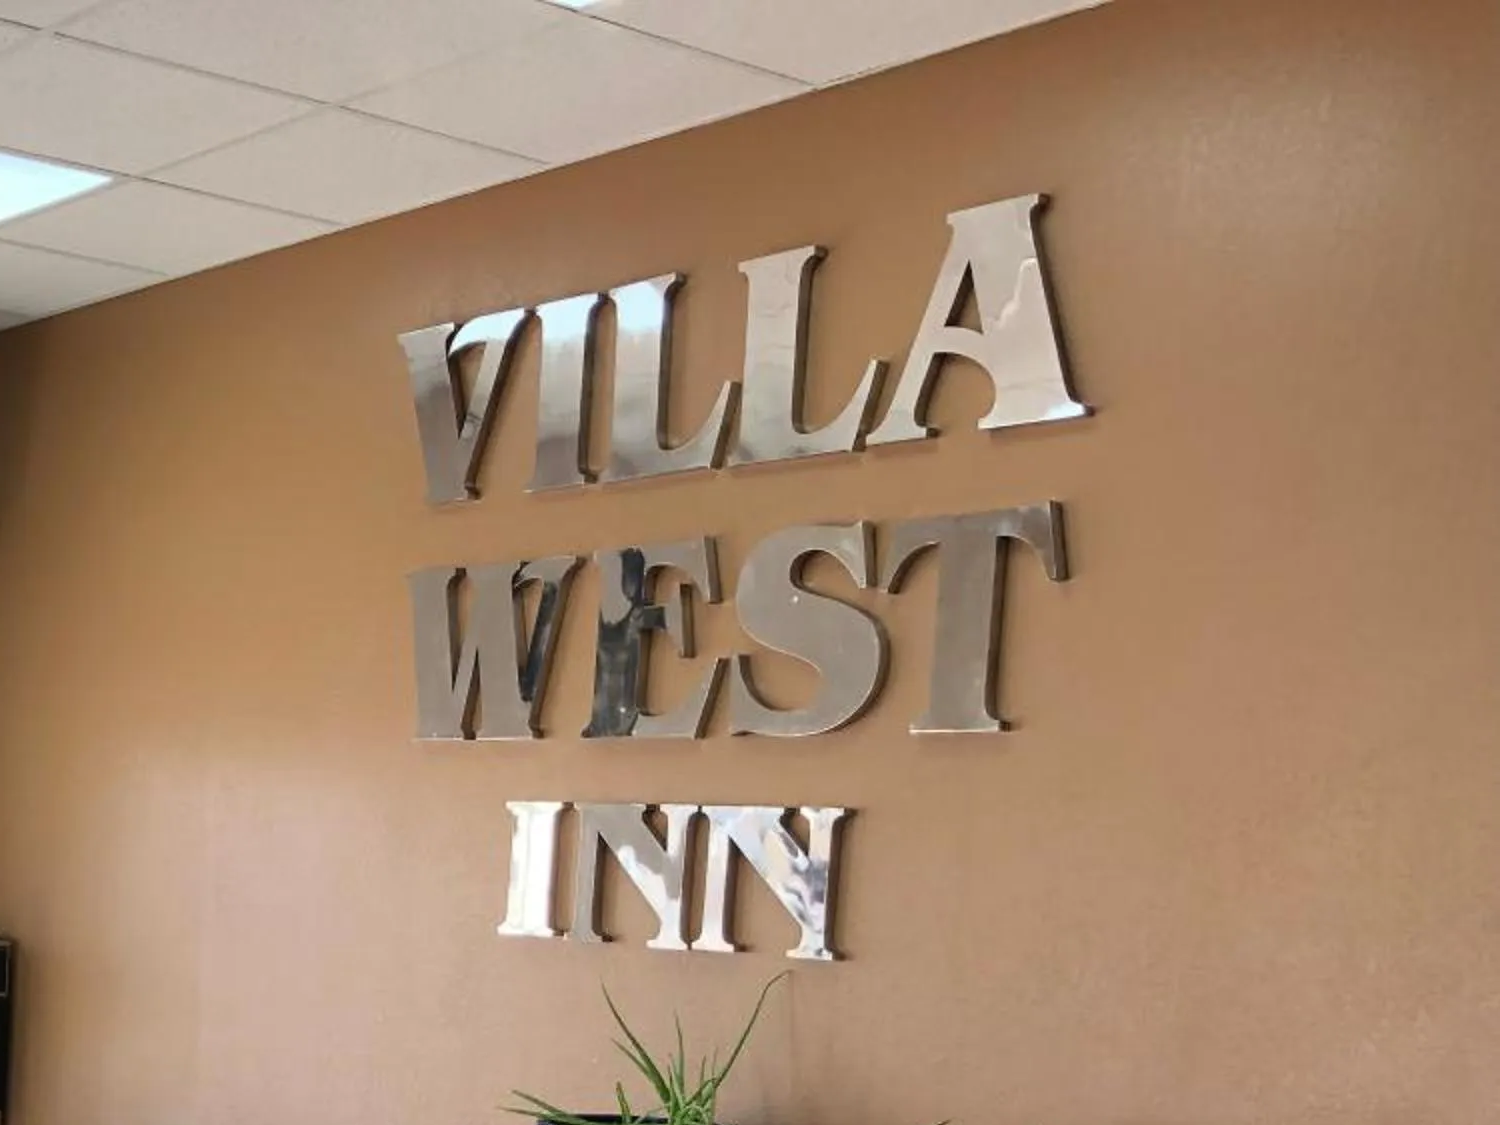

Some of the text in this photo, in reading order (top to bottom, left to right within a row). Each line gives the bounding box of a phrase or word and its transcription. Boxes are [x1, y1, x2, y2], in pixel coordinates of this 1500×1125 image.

[397, 193, 1097, 503] VILLA
[406, 500, 1070, 741] WEST
[496, 800, 856, 961] INN
